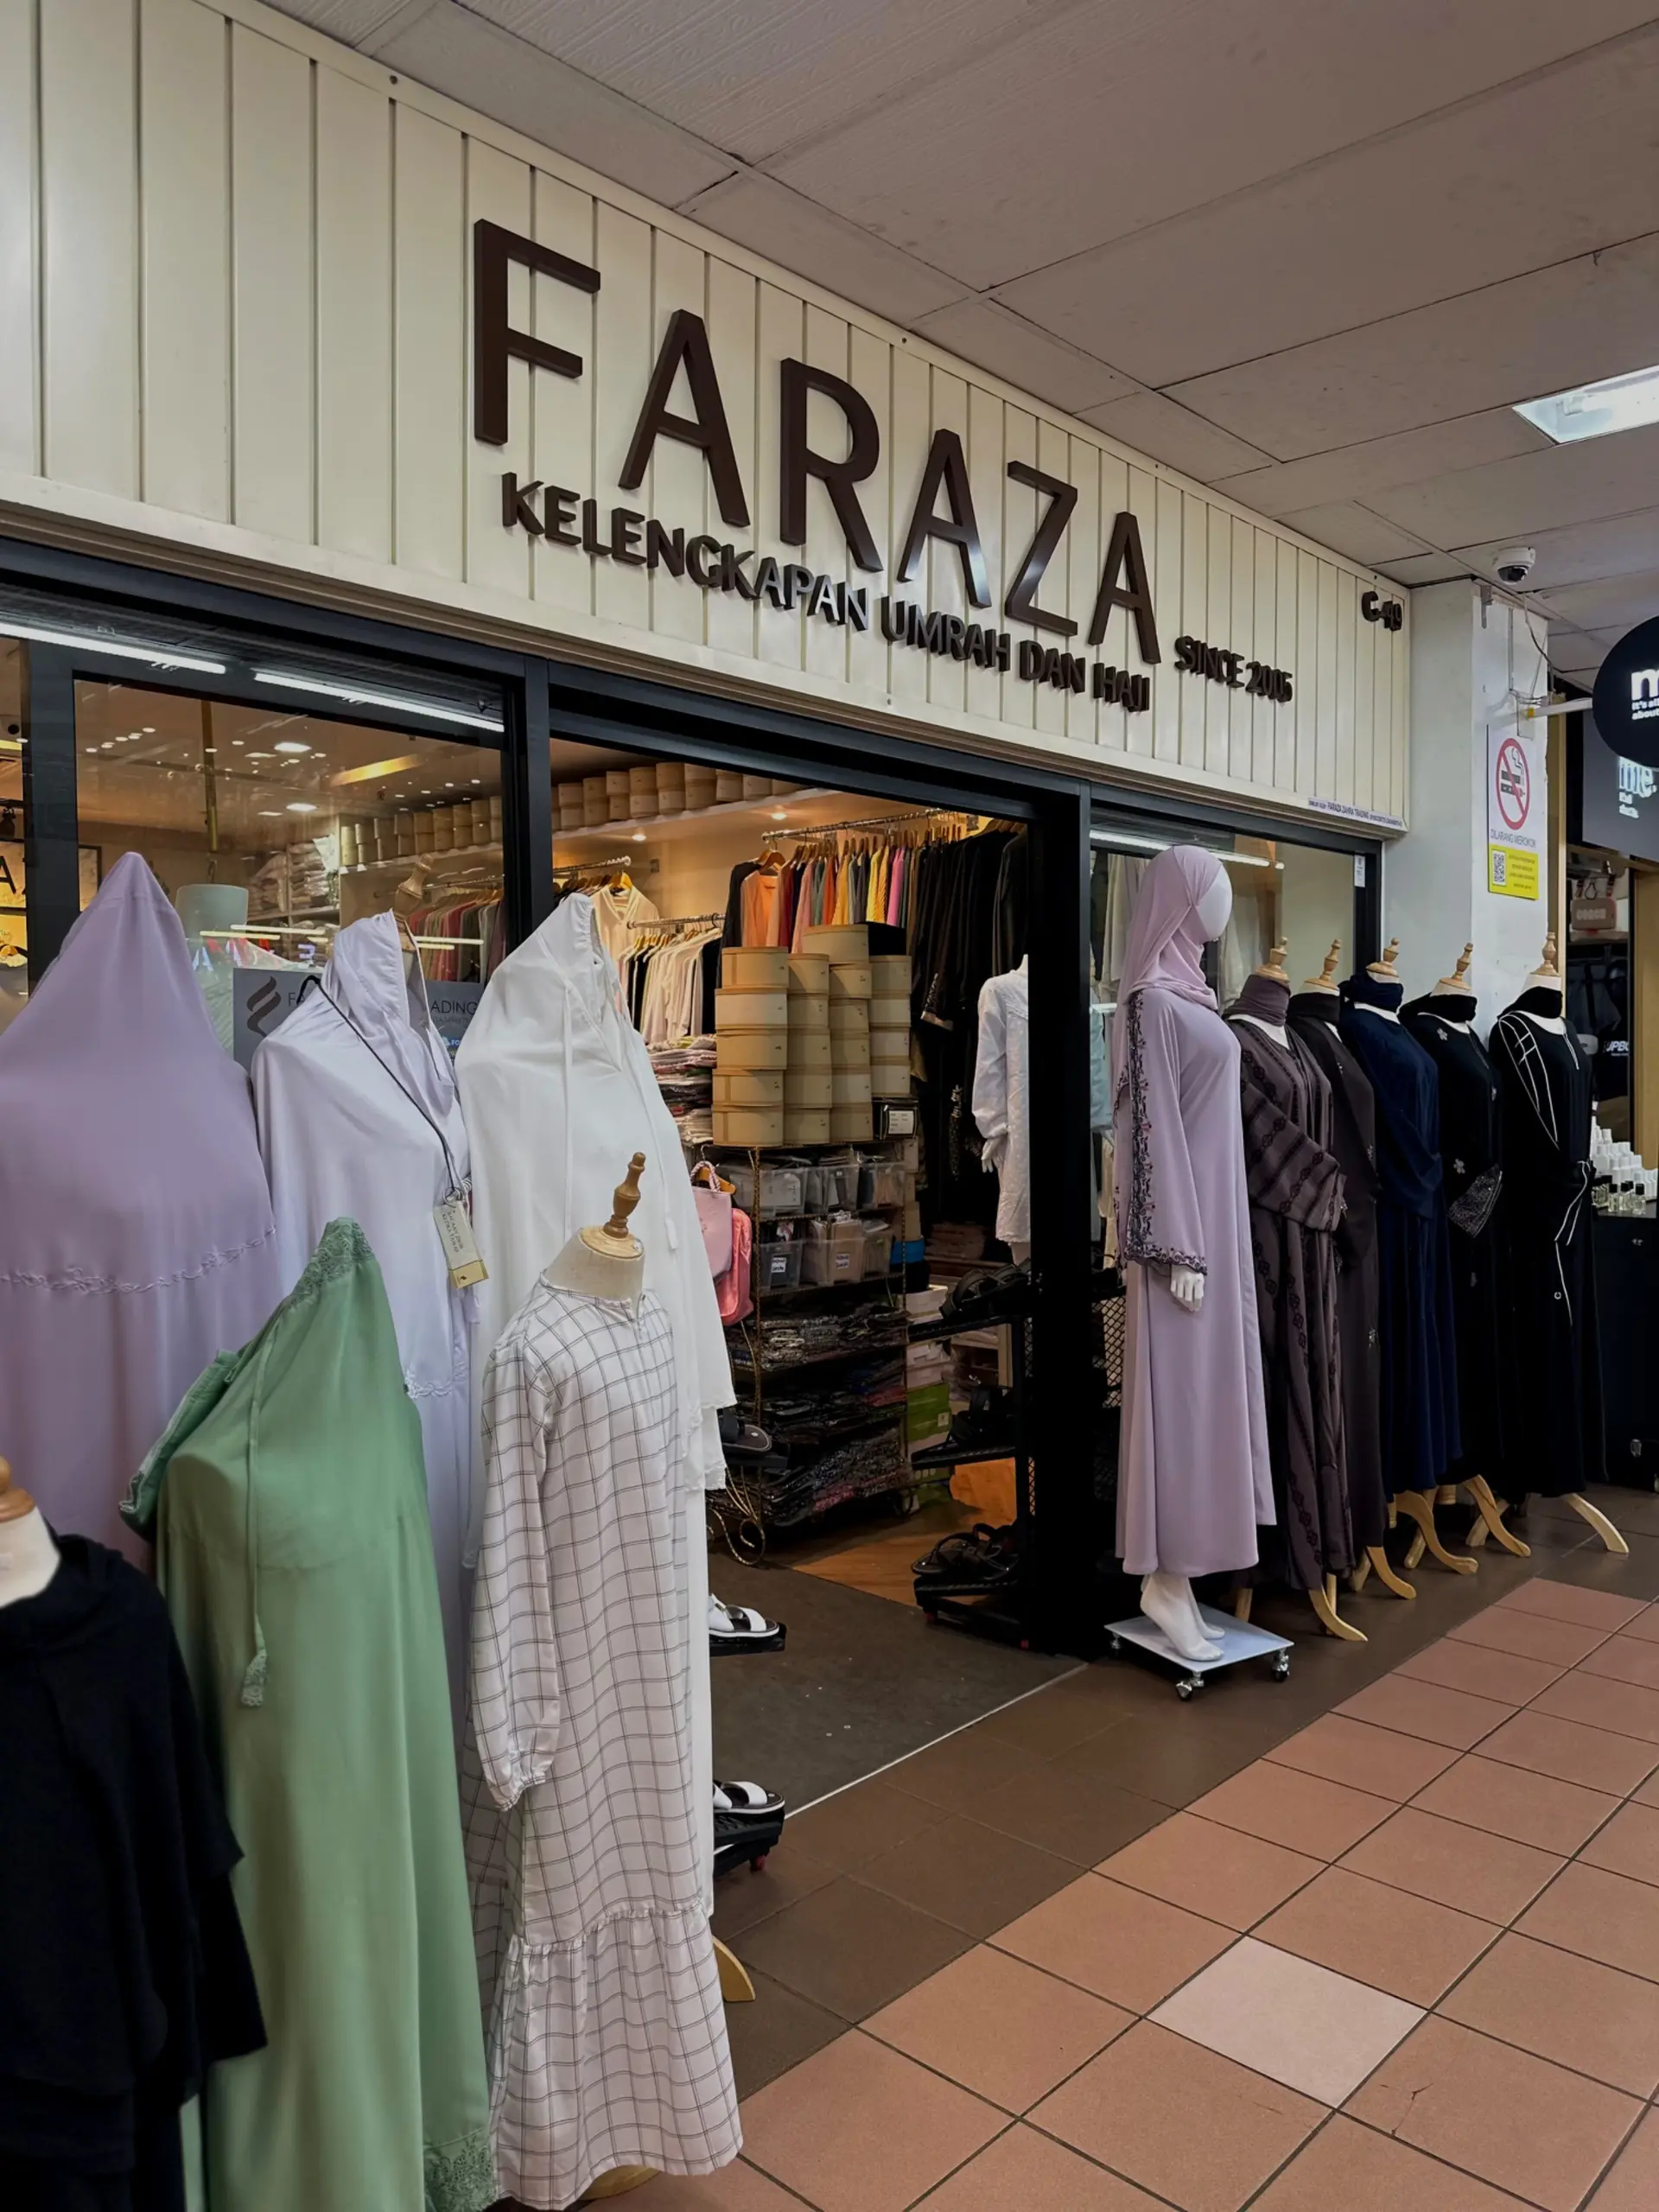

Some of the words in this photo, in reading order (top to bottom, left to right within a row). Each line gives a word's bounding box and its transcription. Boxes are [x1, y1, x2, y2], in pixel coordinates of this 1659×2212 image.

[474, 219, 1161, 664] FARAZA
[502, 472, 868, 631] KELENGKAPAN
[881, 595, 1010, 671] UMRAH
[1020, 640, 1085, 693] DAN
[1093, 663, 1149, 712] HAJI
[1174, 636, 1244, 688] SINCE
